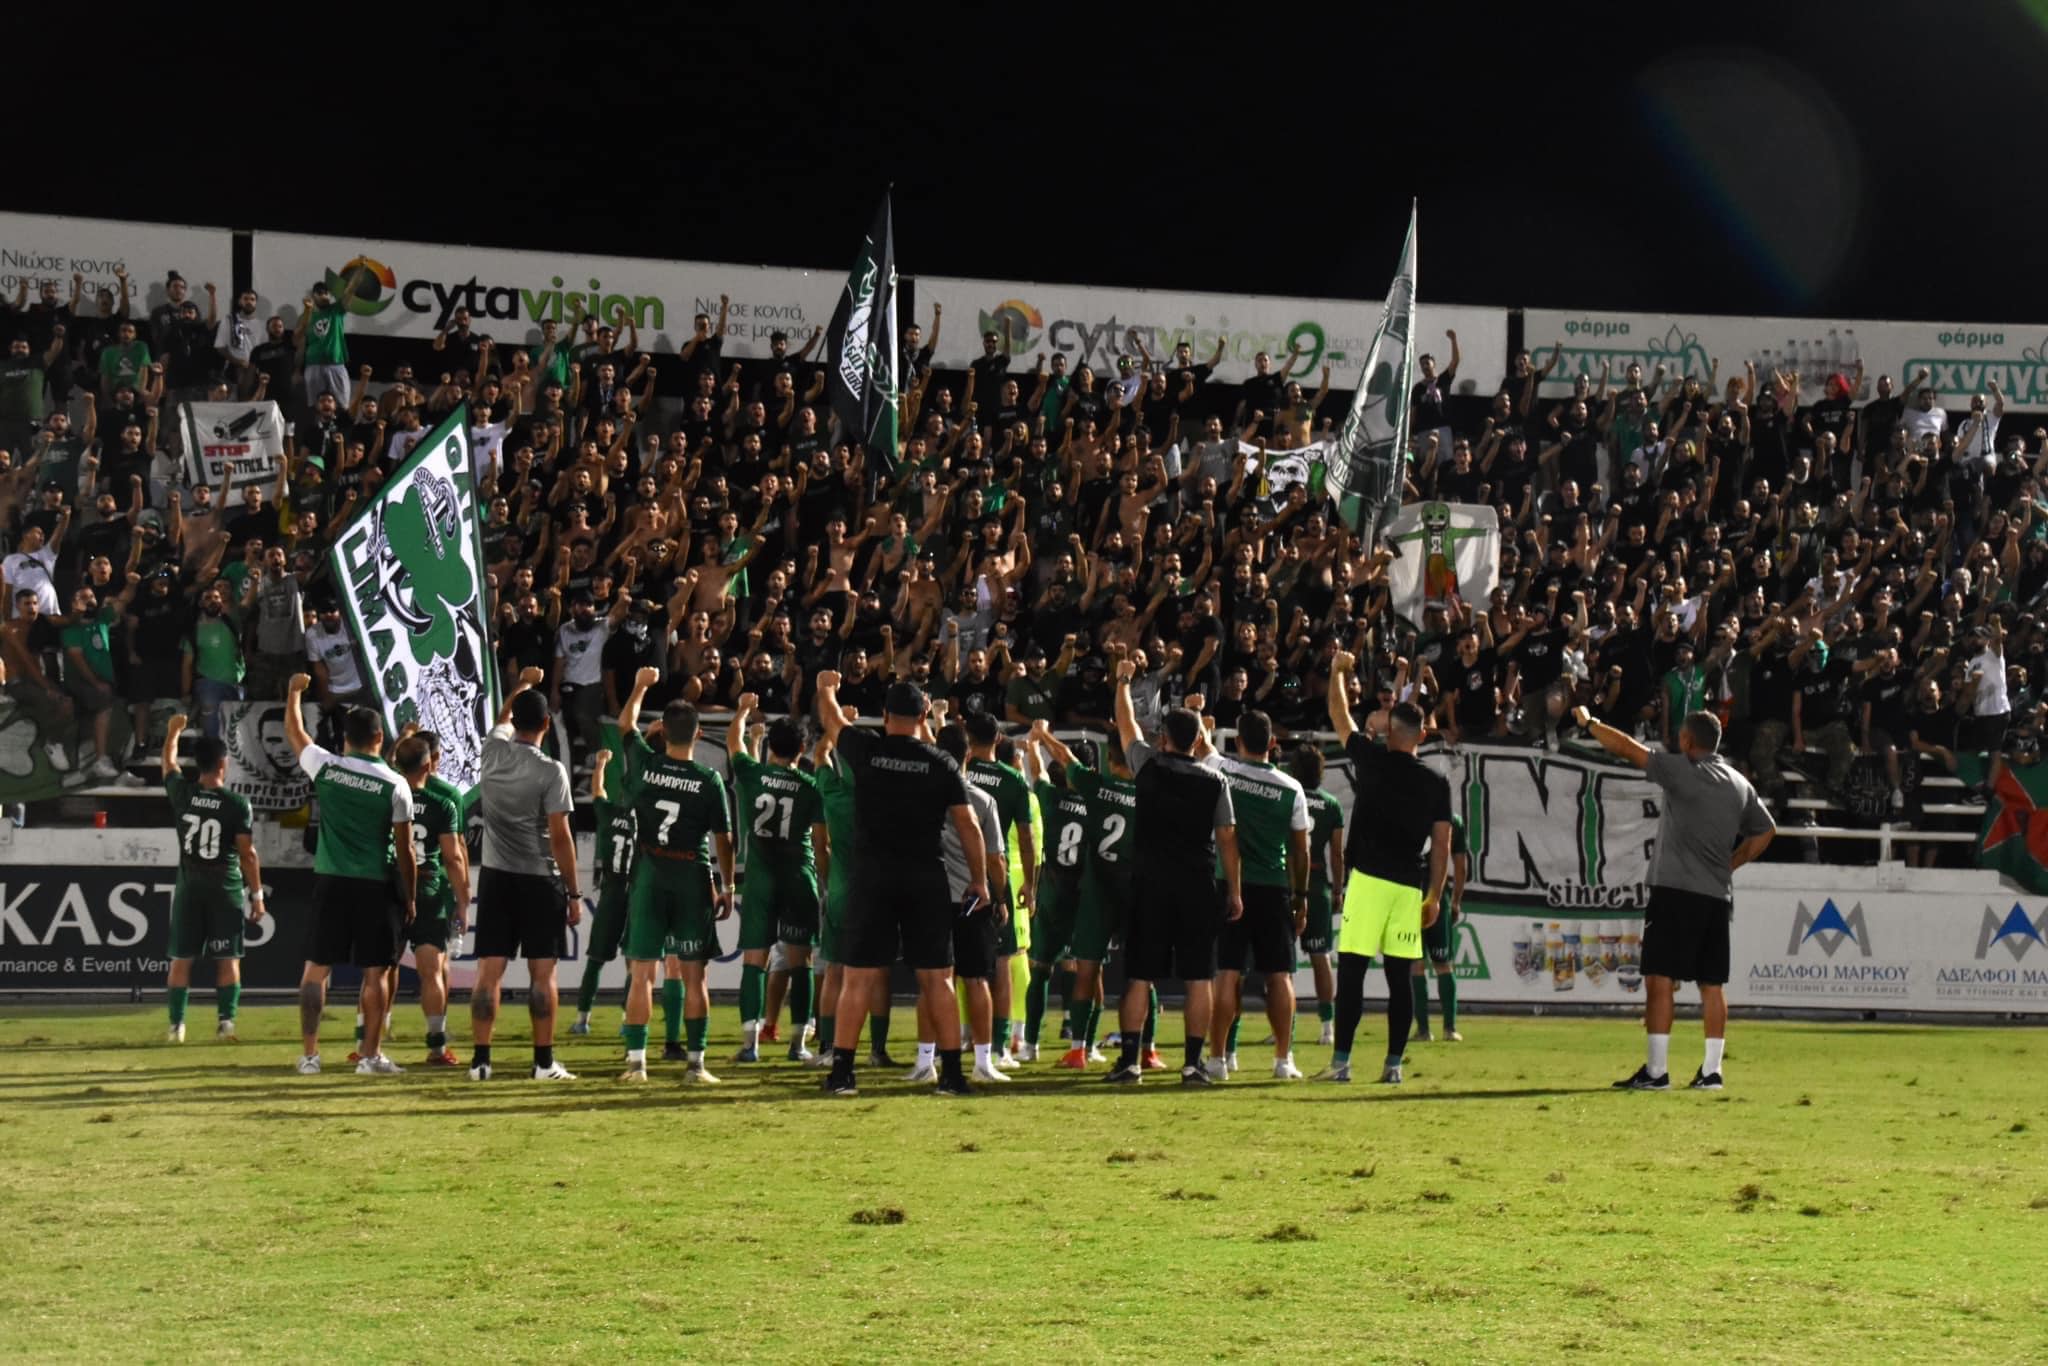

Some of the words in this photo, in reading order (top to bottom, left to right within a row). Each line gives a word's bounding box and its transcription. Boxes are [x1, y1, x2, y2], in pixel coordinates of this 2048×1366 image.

[402, 276, 665, 331] cytavision
[1565, 318, 1630, 337] φάρμα
[1938, 328, 2004, 348] φάρμα
[204, 444, 250, 457] STOP
[211, 456, 275, 477] CTROL!
[655, 800, 681, 846] 7
[754, 793, 795, 840] 21
[182, 813, 222, 860] 70
[1057, 821, 1083, 867] 8
[1098, 813, 1126, 862] 2
[0, 882, 276, 947] KASTS
[63, 958, 76, 973] &
[82, 957, 131, 973] Event
[1749, 964, 1828, 979] ΑΔΕΛΦΟΙ
[1834, 965, 1910, 981] ΜΑΡΚΟΥ
[1936, 967, 2016, 984] ΑΔΕΛΦΟΙ
